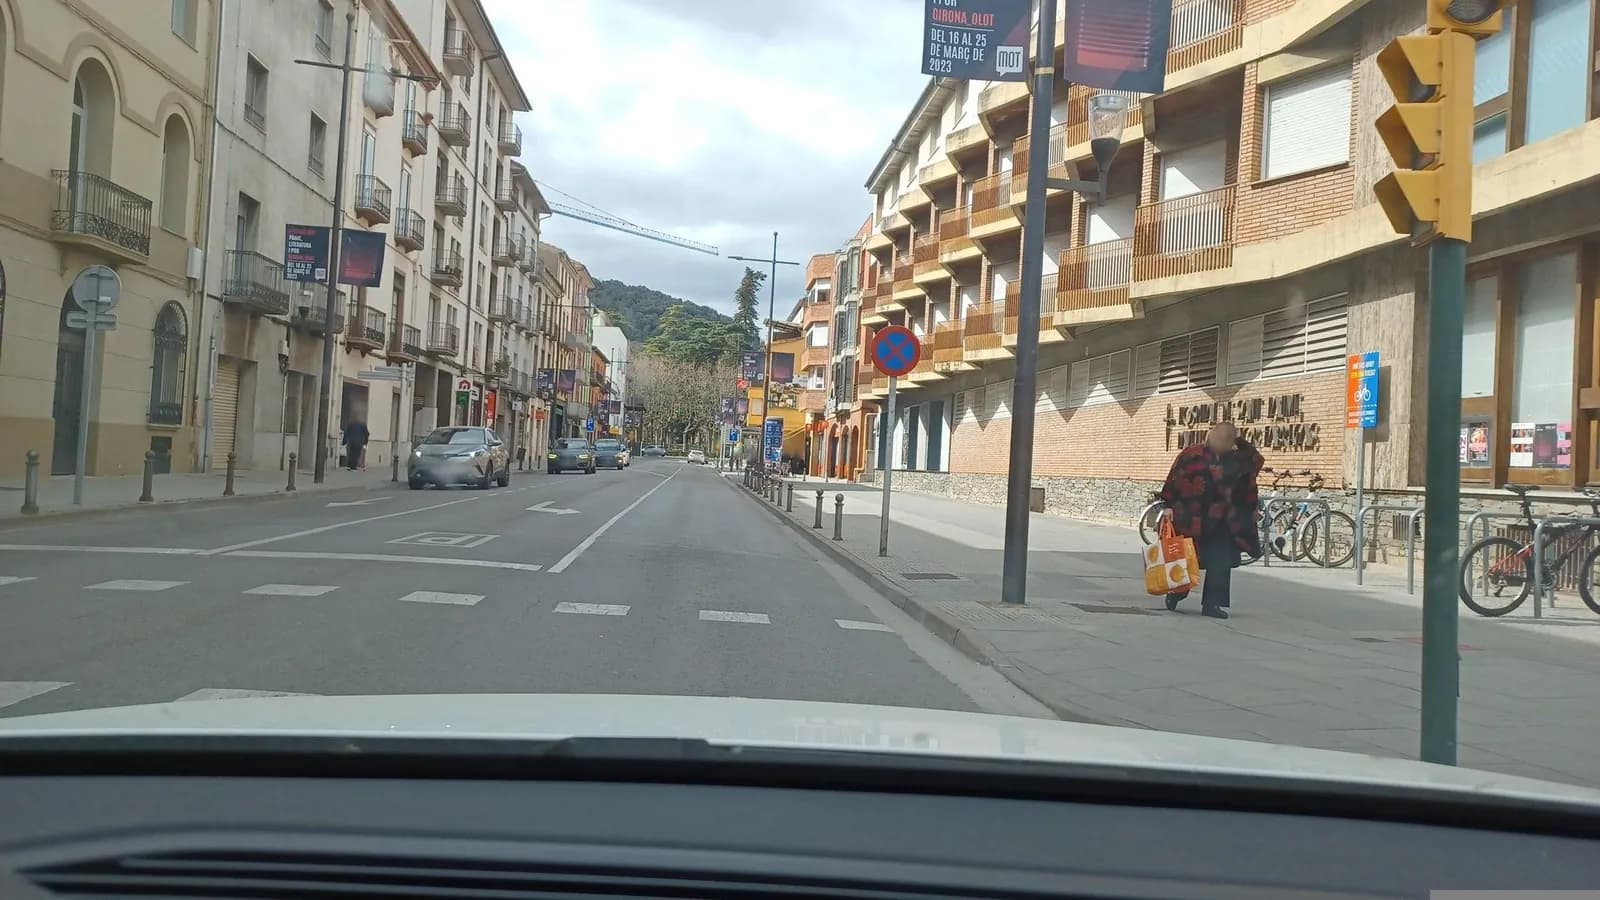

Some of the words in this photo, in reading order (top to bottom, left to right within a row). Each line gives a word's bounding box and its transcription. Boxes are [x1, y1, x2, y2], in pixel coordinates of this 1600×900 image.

[931, 28, 946, 43] DEL
[949, 31, 960, 44] 16
[961, 32, 973, 46] AL
[975, 33, 987, 47] 25
[930, 42, 942, 57] DE
[943, 45, 970, 64] MARÇ
[972, 48, 984, 61] DE
[998, 50, 1021, 68] MOT
[929, 57, 952, 73] 2023
